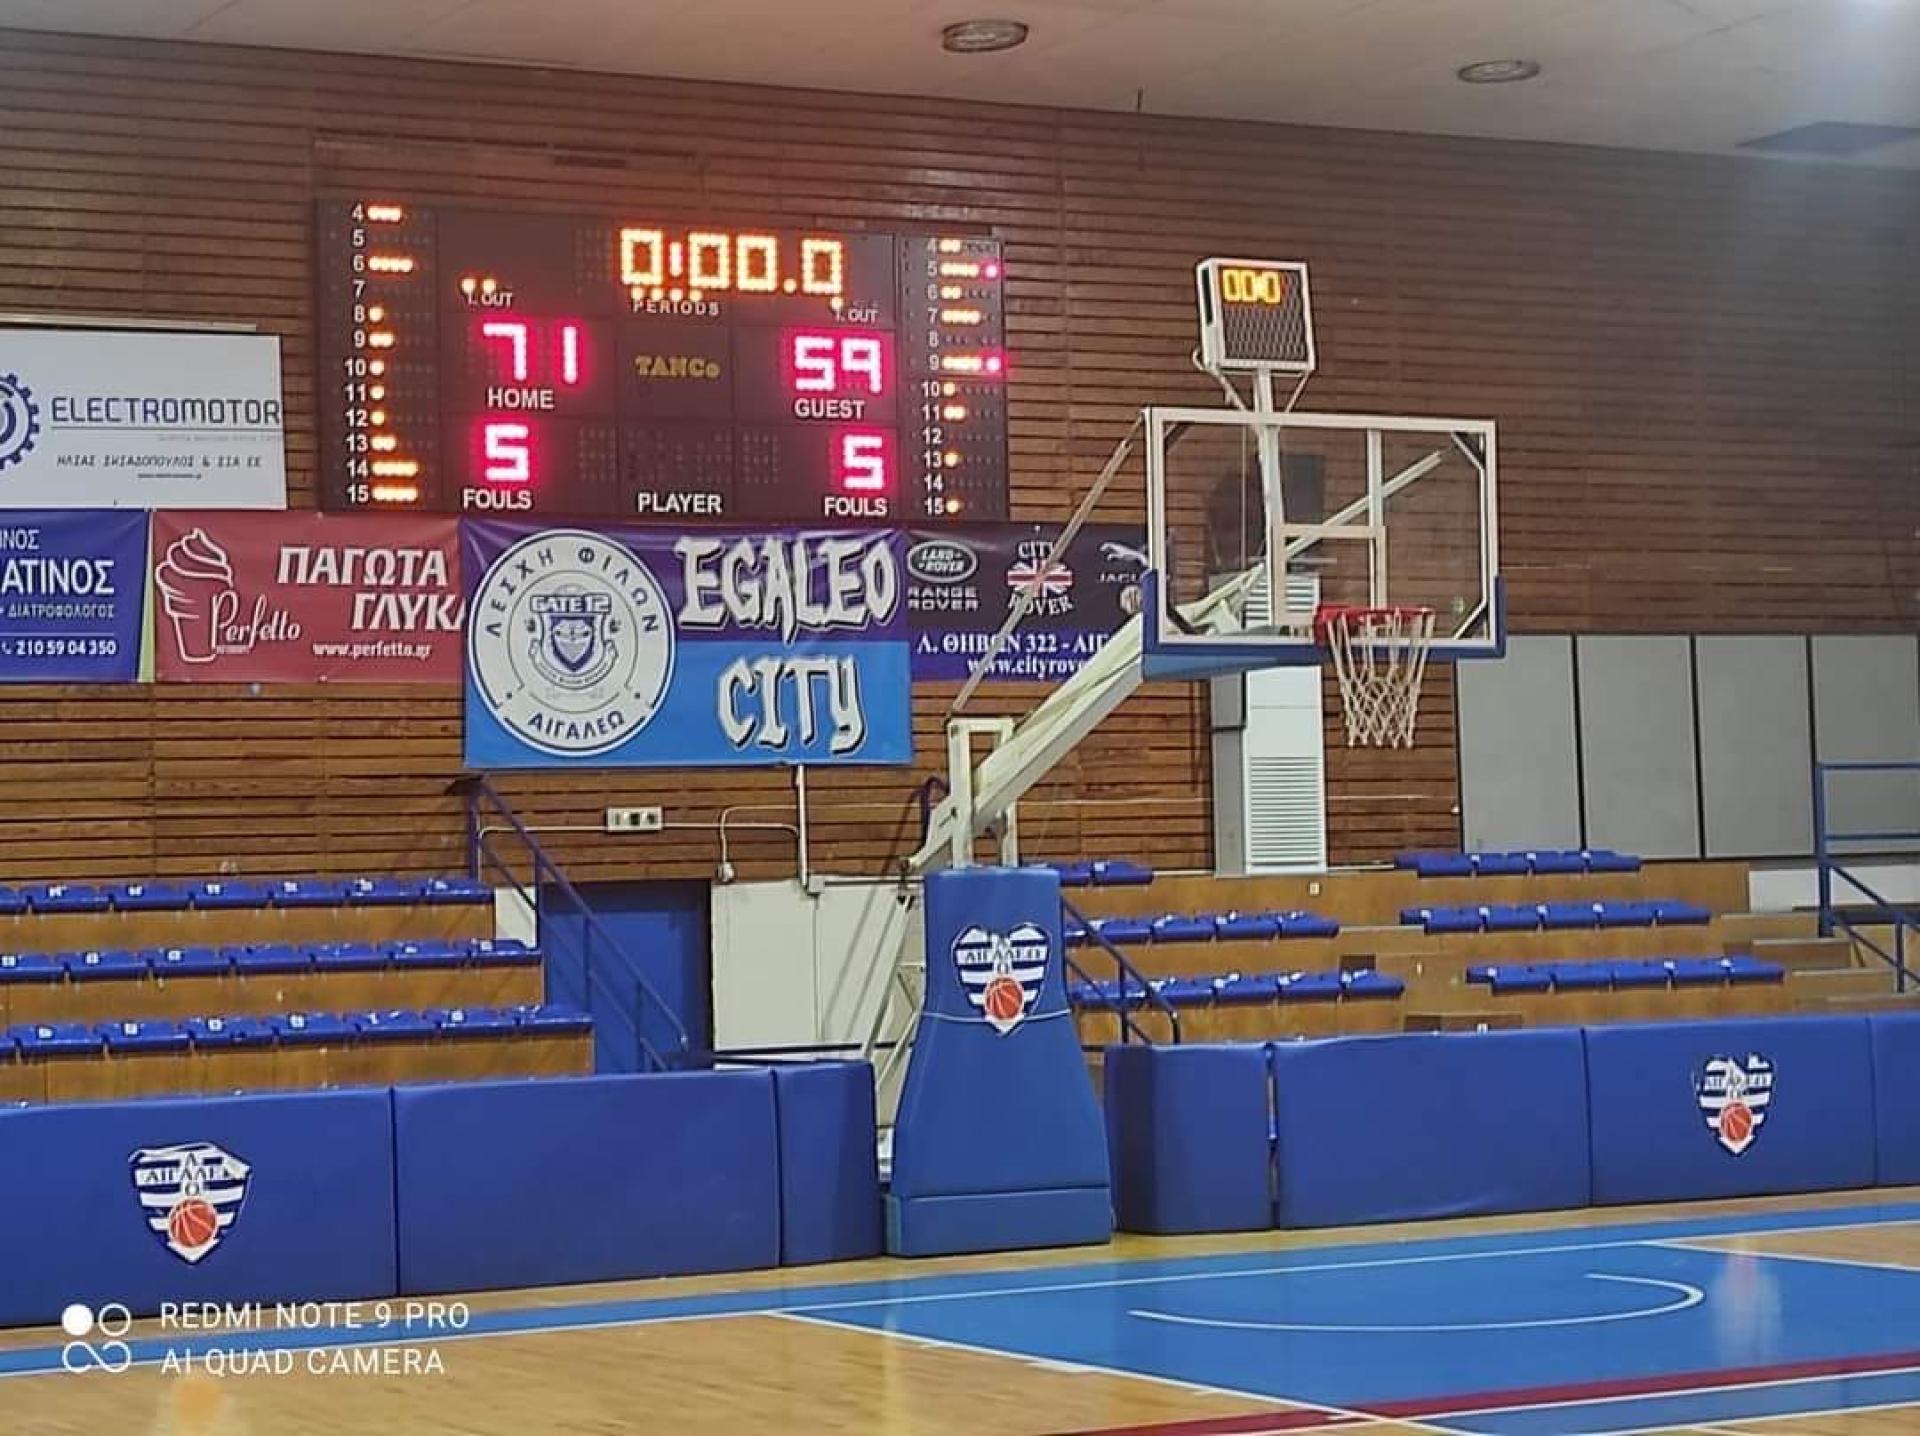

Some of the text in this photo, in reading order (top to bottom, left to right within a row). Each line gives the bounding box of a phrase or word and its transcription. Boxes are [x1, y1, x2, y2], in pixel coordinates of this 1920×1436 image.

[353, 204, 364, 222] 4
[353, 229, 364, 247] 5
[353, 255, 364, 273] 6
[927, 261, 938, 276] 5
[353, 279, 364, 298] 7
[927, 284, 938, 299] 6
[481, 292, 514, 306] OUT
[632, 300, 720, 316] PERIODS
[354, 305, 365, 323] 8
[848, 308, 879, 323] OUT
[927, 308, 938, 322] 7
[354, 330, 365, 349] 9
[928, 332, 939, 346] 8
[483, 322, 579, 385] 71
[345, 359, 366, 377] 10
[793, 335, 882, 394] 59
[928, 356, 939, 371] 9
[345, 384, 367, 402] 11
[487, 387, 555, 410] HOME
[921, 382, 940, 397] 10
[51, 396, 281, 425] ELECTROMOTOR
[346, 409, 368, 428] 12
[794, 399, 866, 420] GUEST
[921, 406, 940, 420] 11
[346, 434, 368, 452] 13
[922, 429, 942, 444] 12
[484, 423, 530, 482] 5
[923, 452, 942, 467] 13
[347, 459, 369, 477] 14
[843, 434, 884, 490] 5
[924, 475, 943, 489] 14
[347, 485, 369, 502] 15
[463, 488, 533, 509] FOULS
[637, 492, 723, 514] PLAYER
[824, 496, 888, 517] FOULS
[924, 499, 944, 514] 15
[277, 546, 449, 587] ΠΑΓΩΤΑ
[485, 546, 658, 638] ΛΕΣΧΗ ΦΙΛΩΝ
[674, 535, 899, 645] EGALEO
[907, 586, 977, 598] RANGE
[907, 599, 979, 611] ROVER
[211, 590, 301, 648] Perfetto
[16, 639, 44, 655] 210
[47, 639, 65, 655] 59
[312, 640, 432, 660] www.perfetto.gr
[1026, 634, 1057, 653] 322
[718, 654, 866, 755] CITY
[527, 709, 626, 740] ΑΙΓΑΛΕΩ
